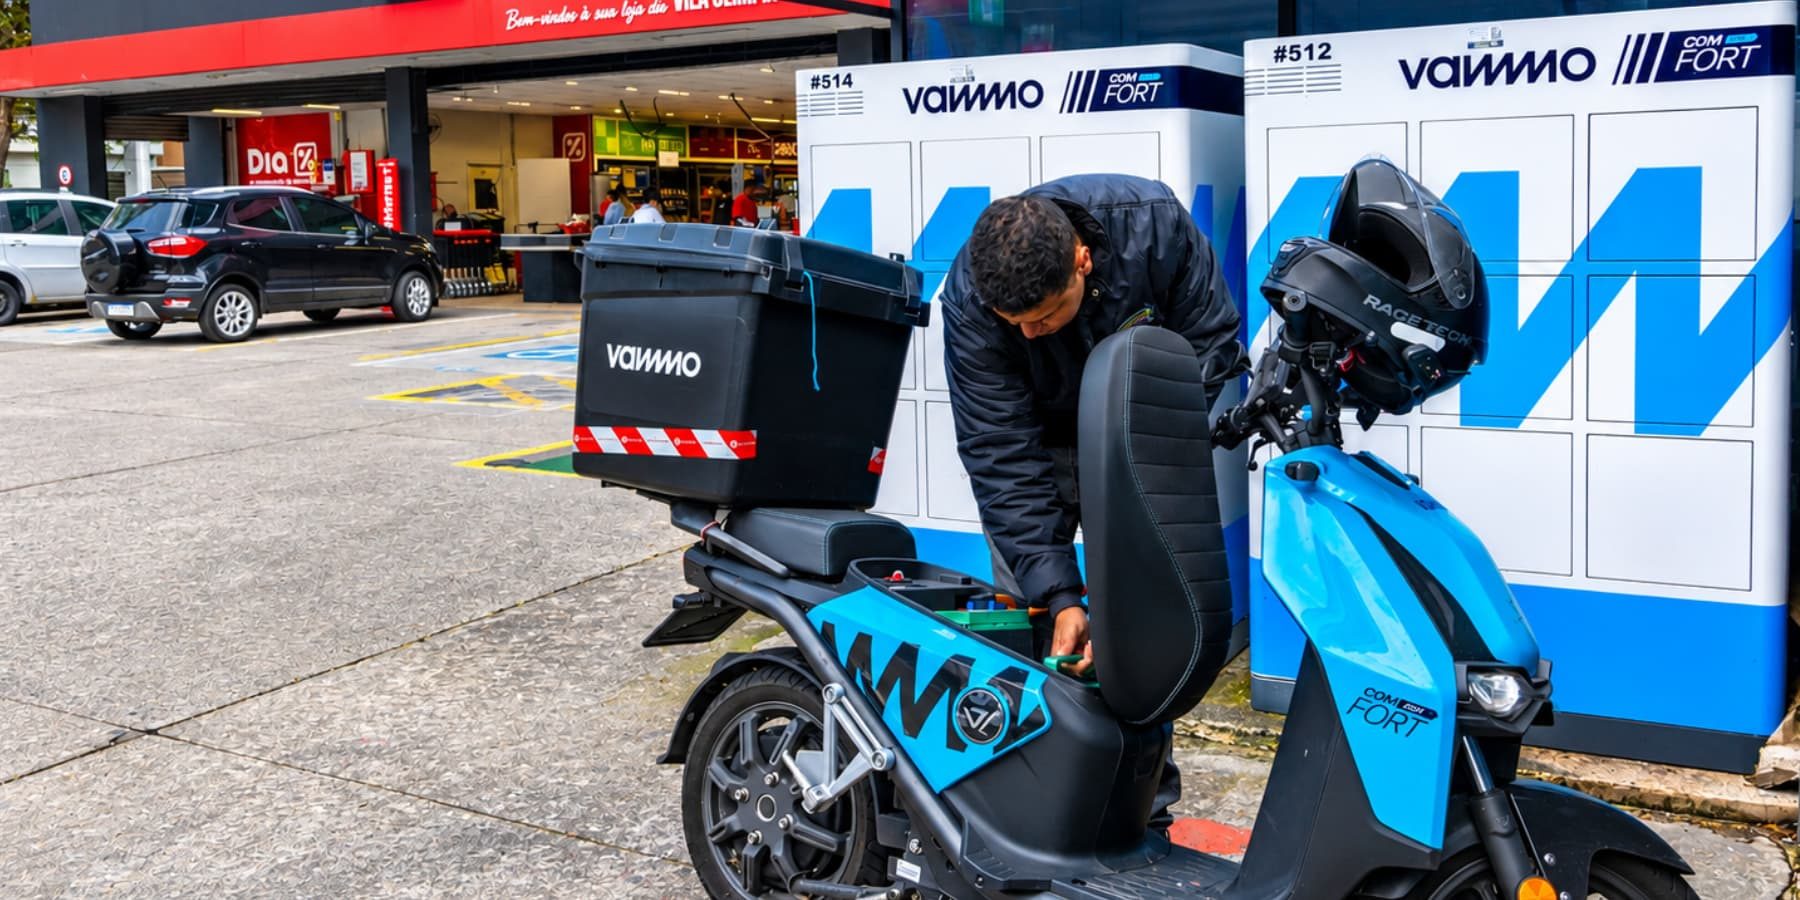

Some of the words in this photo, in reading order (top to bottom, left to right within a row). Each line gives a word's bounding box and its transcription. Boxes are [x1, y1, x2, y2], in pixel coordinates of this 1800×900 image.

[506, 6, 577, 30] Bem-vindos
[594, 8, 618, 20] sua
[621, 0, 646, 24] loja
[1273, 42, 1332, 63] #512
[1683, 34, 1723, 48] COM
[1398, 47, 1597, 90] vammo
[1674, 45, 1761, 72] FORT
[810, 72, 853, 89] #514
[1109, 72, 1137, 83] COM
[902, 79, 1044, 114] vammo
[1103, 82, 1164, 104] FORT
[606, 343, 702, 378] vammo
[1363, 687, 1399, 707] COM
[1346, 696, 1430, 737] FORT
